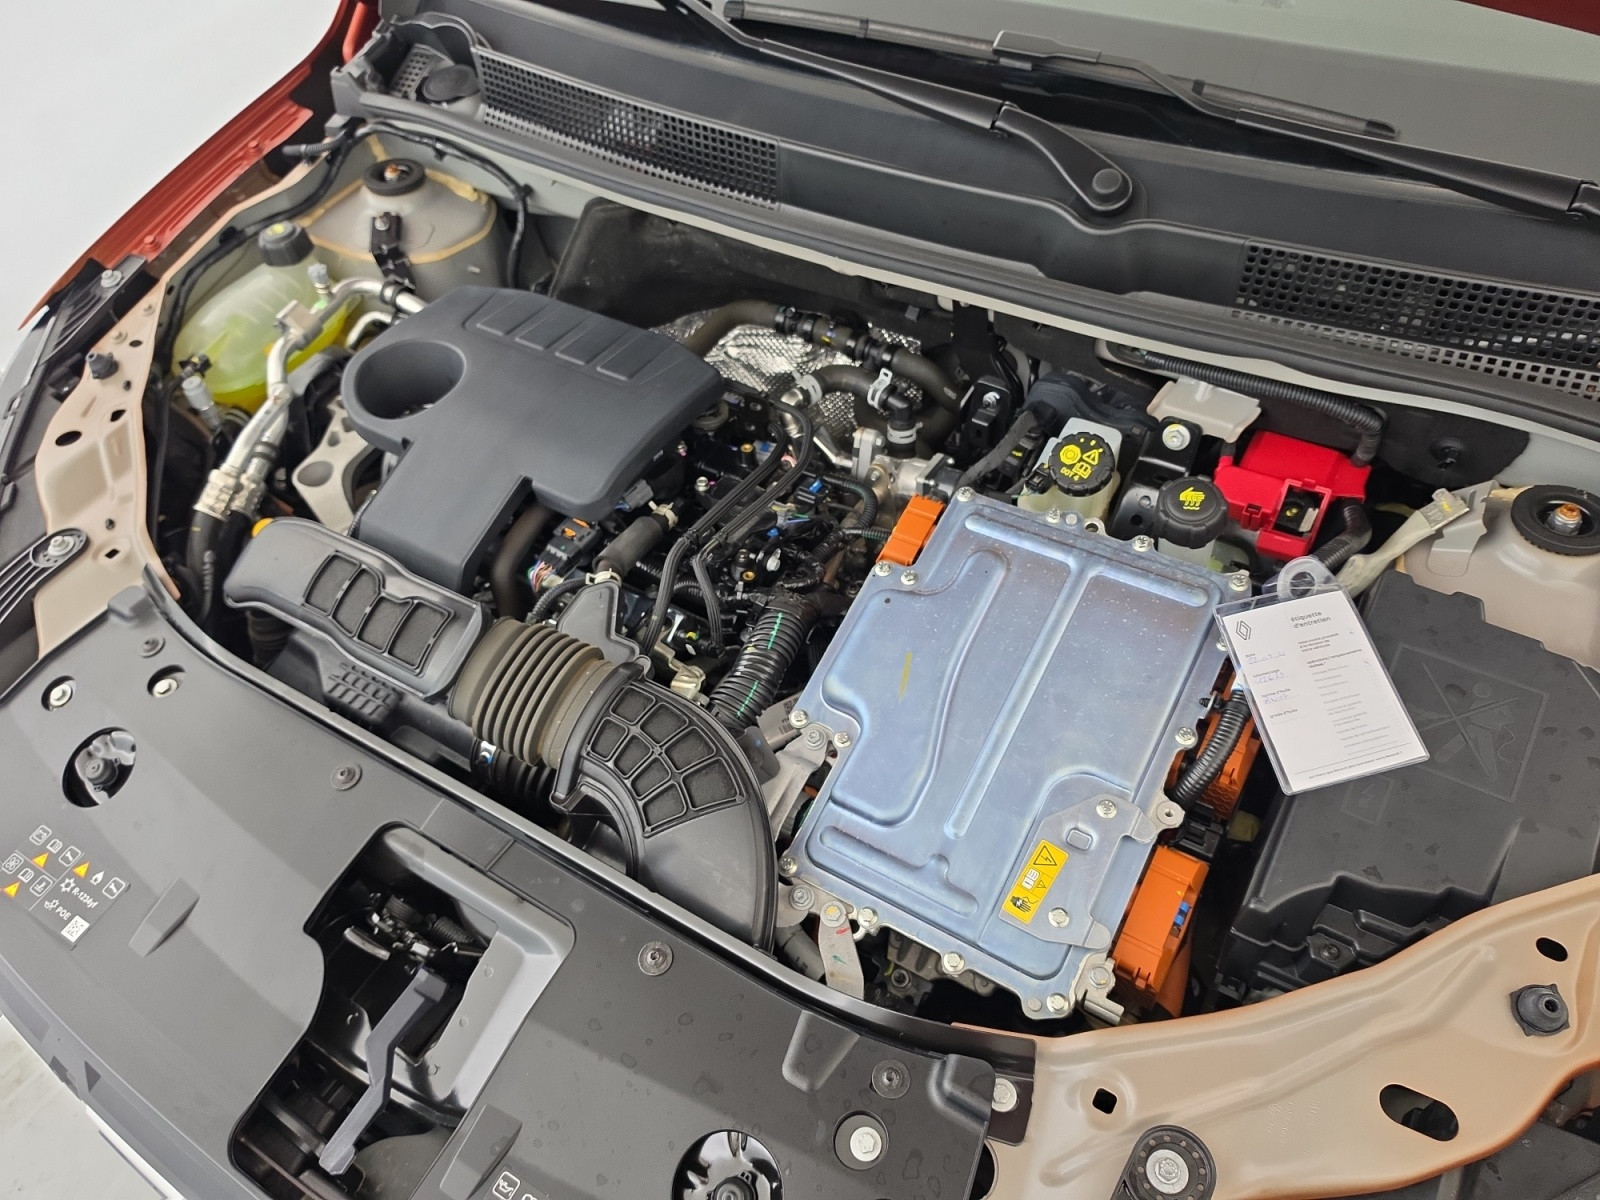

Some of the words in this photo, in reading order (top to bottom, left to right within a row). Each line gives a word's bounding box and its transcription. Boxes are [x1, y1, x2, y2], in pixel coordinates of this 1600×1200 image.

[1060, 467, 1074, 477] DOT
[1291, 611, 1322, 622] étiquette
[1293, 616, 1331, 628] d'entretien
[71, 887, 98, 908] R-1234yf
[55, 906, 71, 920] POE
